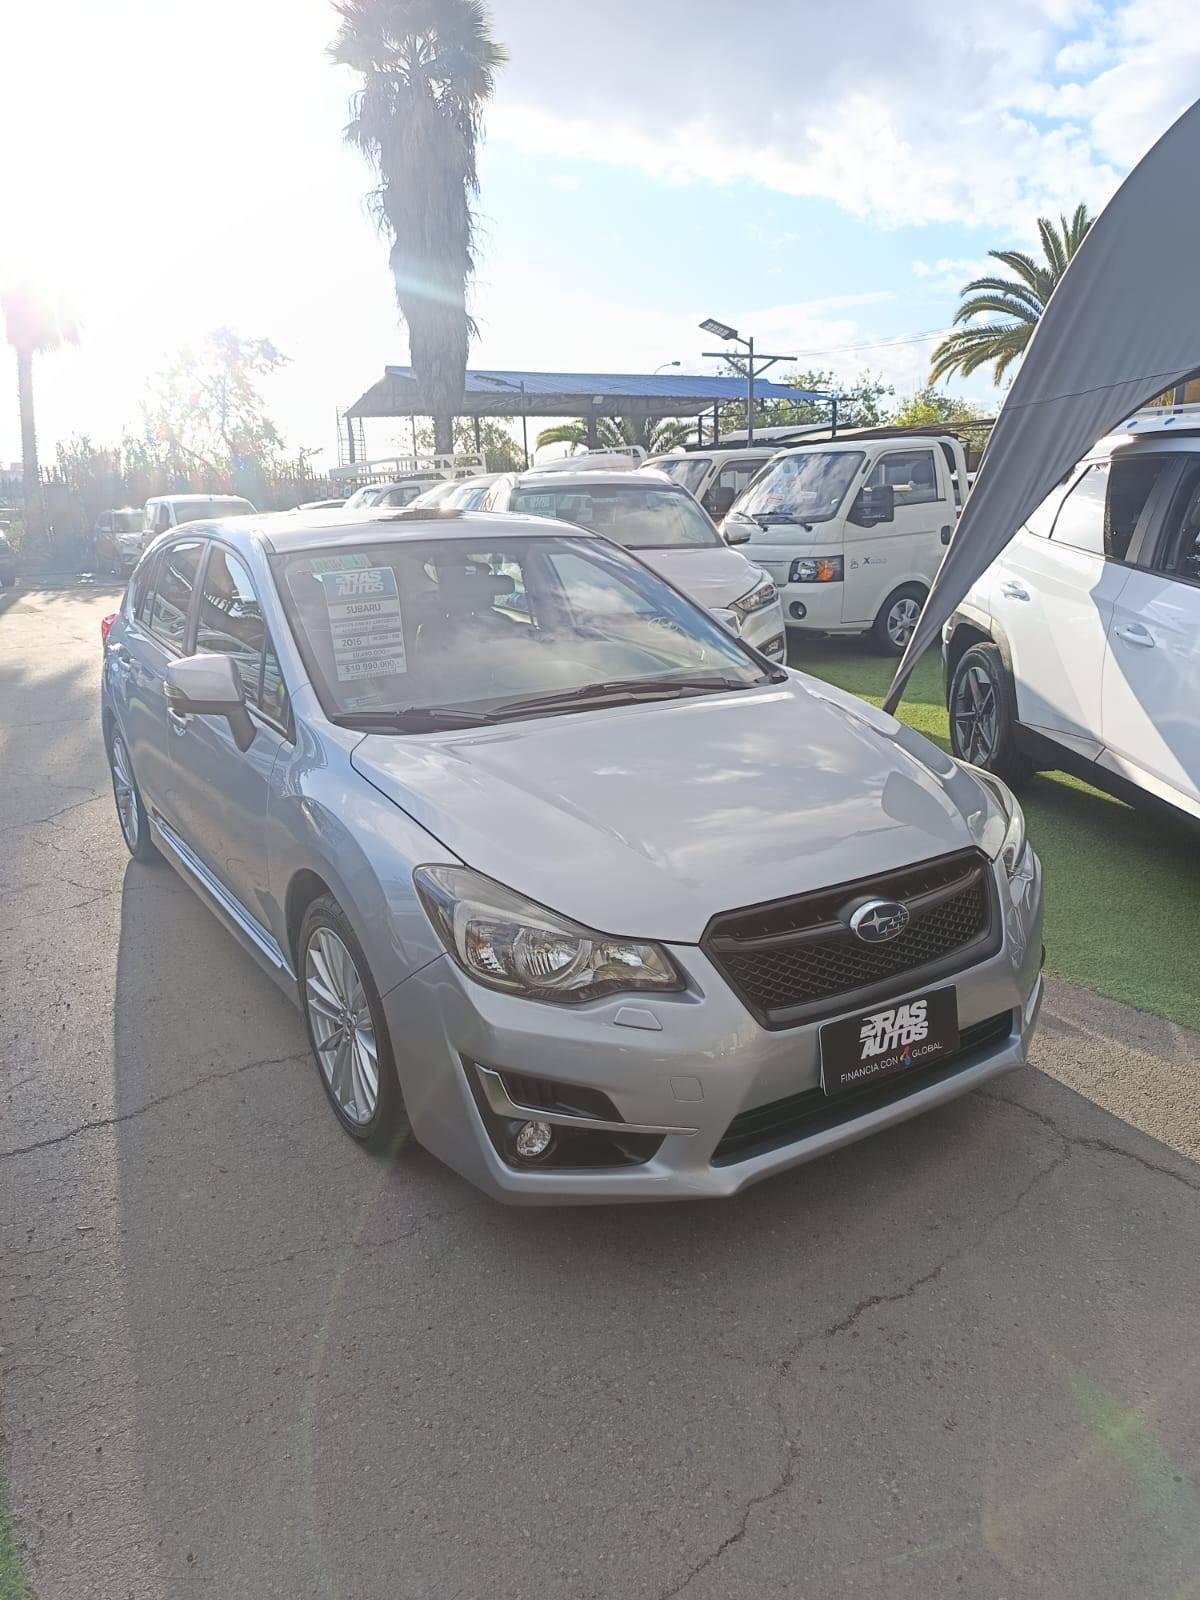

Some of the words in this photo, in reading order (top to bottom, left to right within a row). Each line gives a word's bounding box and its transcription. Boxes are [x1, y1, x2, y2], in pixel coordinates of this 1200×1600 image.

[346, 603, 381, 614] SUBARU
[859, 1020, 929, 1060] AUTOS
[840, 1063, 880, 1084] FINANCIA
[880, 1056, 899, 1069] CON
[911, 1042, 943, 1058] GLOBAL
